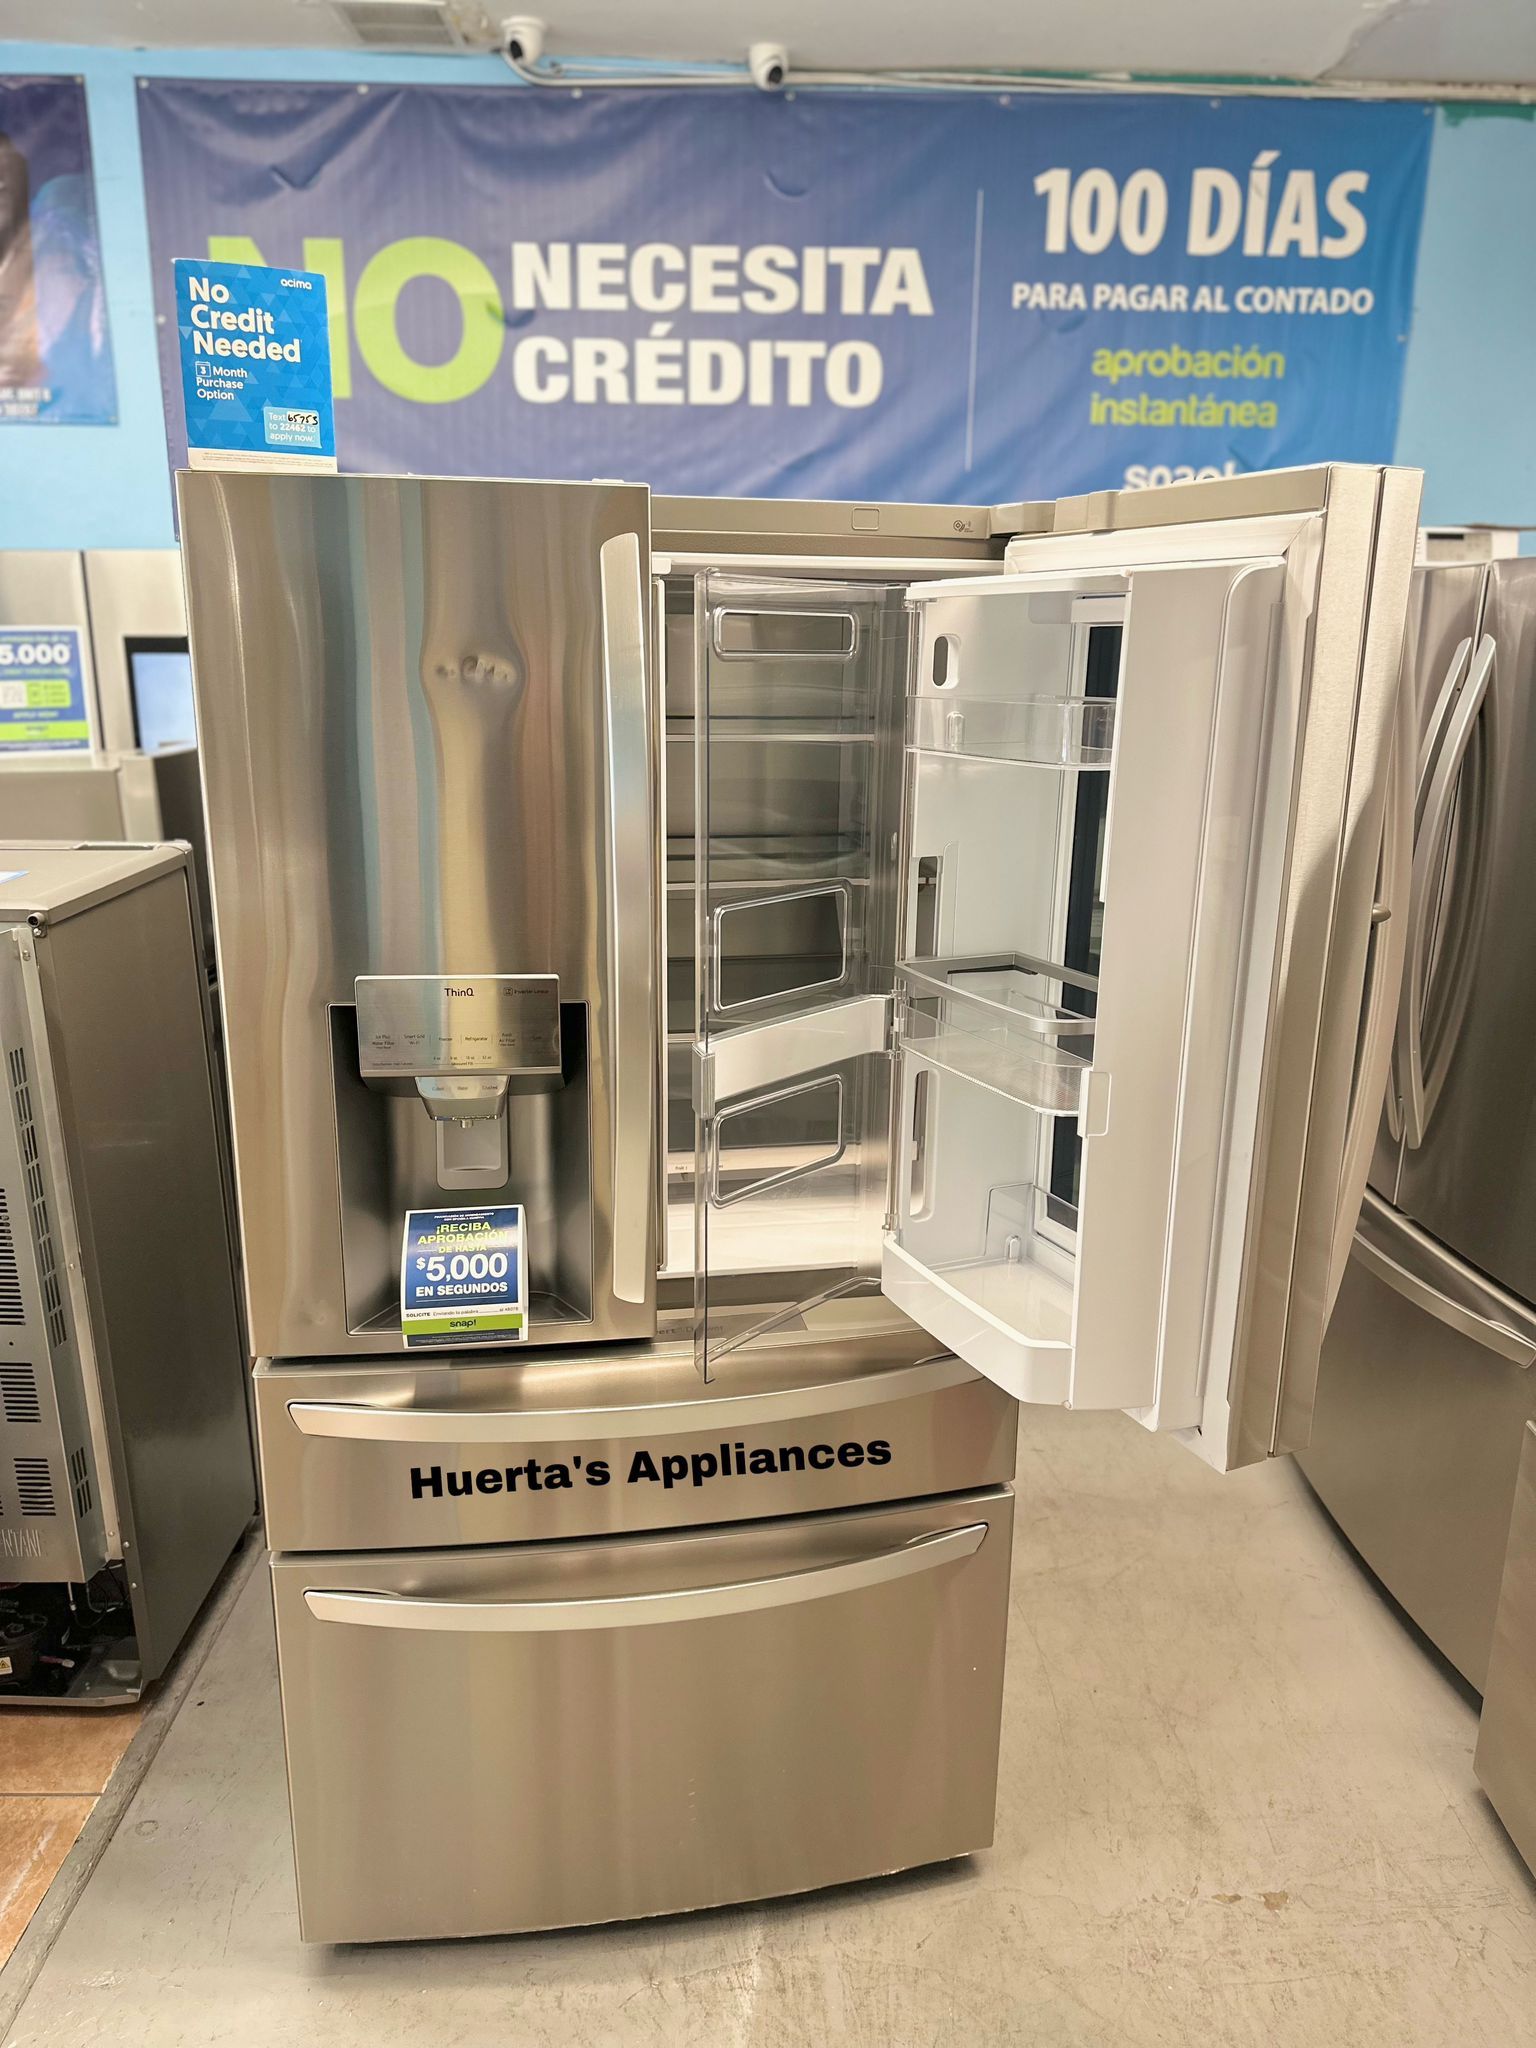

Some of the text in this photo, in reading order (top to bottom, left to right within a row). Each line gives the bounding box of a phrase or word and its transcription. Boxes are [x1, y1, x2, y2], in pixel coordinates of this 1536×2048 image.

[1033, 150, 1370, 259] 100 DÍAS
[280, 278, 313, 290] acima
[511, 242, 935, 315] NECESITA
[189, 276, 230, 304] No
[1012, 282, 1374, 315] PARA PAGAR AL CONTADO
[190, 303, 275, 335] Credit
[193, 330, 301, 363] Needed
[513, 322, 883, 408] CRÉDITO
[1092, 343, 1285, 384] aprobación
[200, 366, 248, 378] 3 Month
[196, 376, 244, 389] Purchase
[197, 388, 235, 401] Option
[269, 412, 286, 422] Text
[1090, 393, 1278, 428] instantánea
[270, 432, 293, 442] apply
[444, 988, 475, 997] ThinQ
[436, 1221, 491, 1234] ¡RECIBA
[418, 1230, 508, 1245] APROBACIÓN
[455, 1244, 487, 1253] HASTA
[416, 1252, 508, 1282] $5,000
[416, 1282, 508, 1297] EN SEGUNDOS
[449, 1319, 477, 1328] snap!
